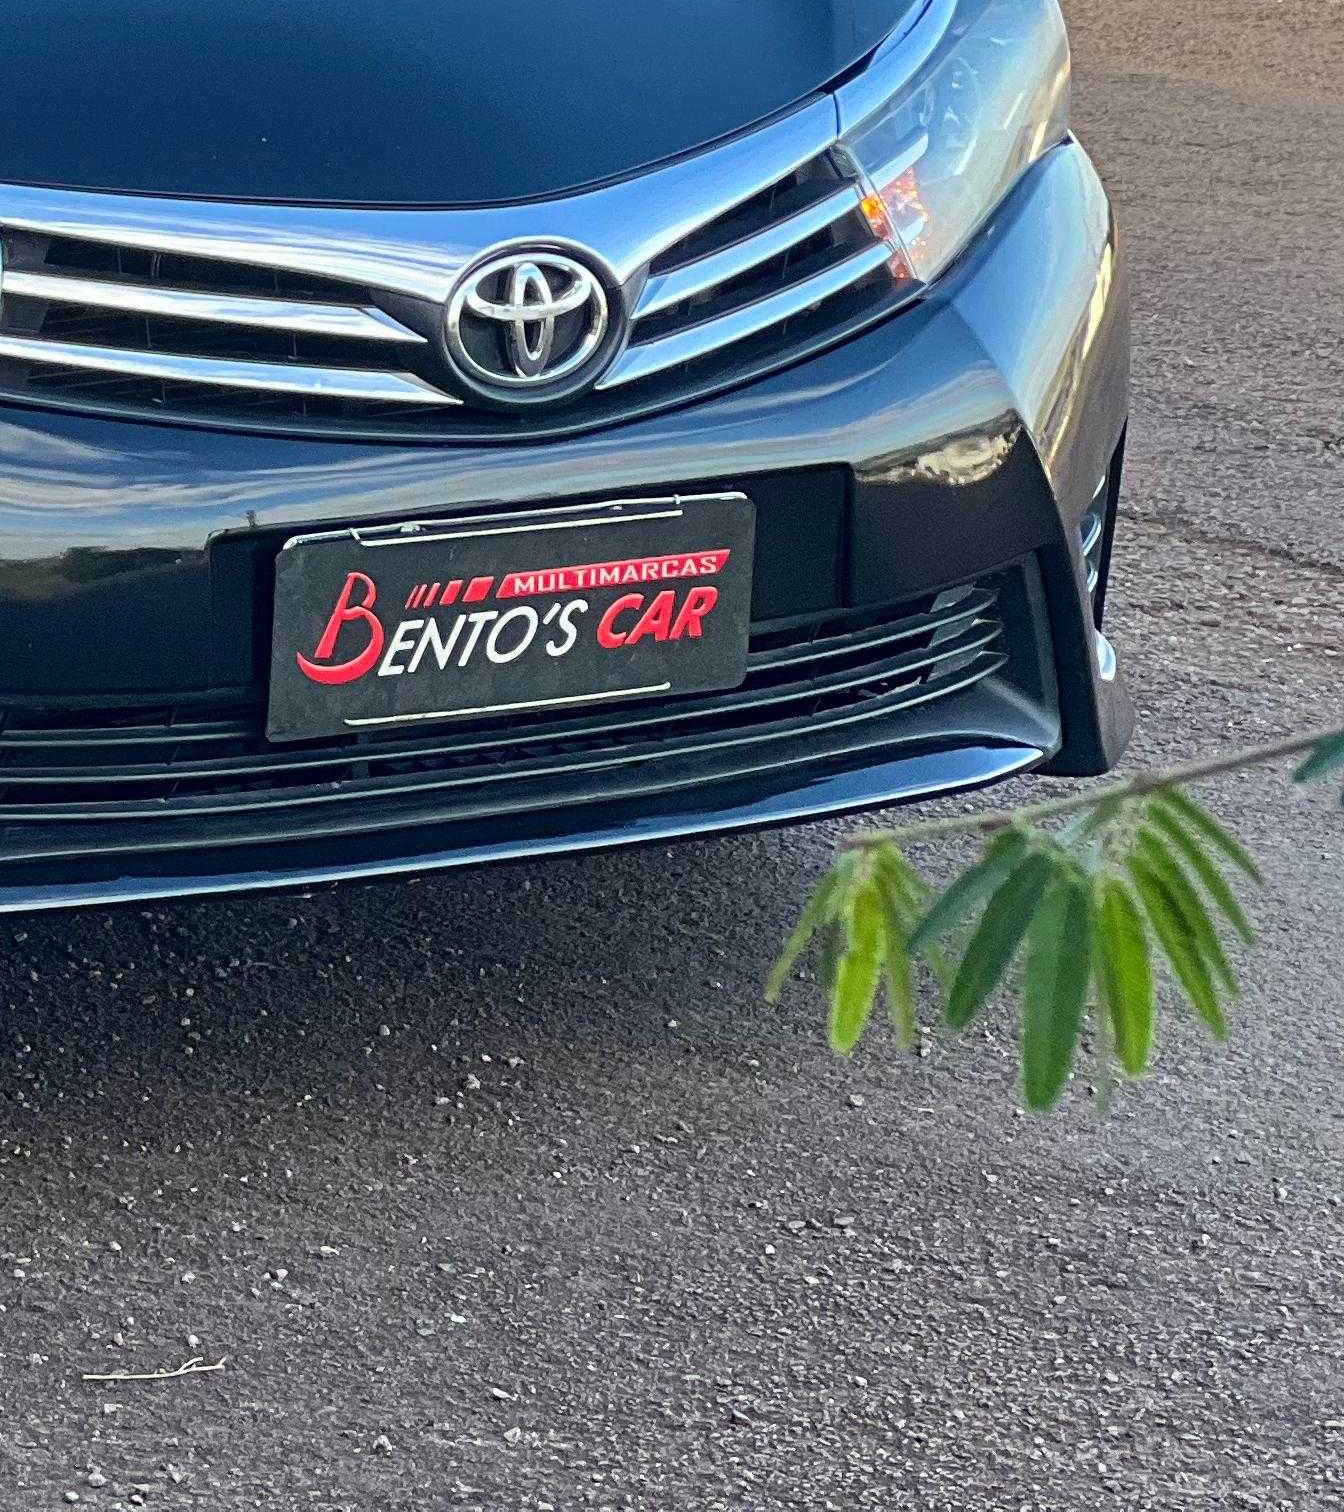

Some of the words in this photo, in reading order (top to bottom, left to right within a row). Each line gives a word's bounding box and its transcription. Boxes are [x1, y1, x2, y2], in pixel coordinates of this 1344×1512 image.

[512, 555, 718, 597] MULTIMARCAS
[296, 572, 589, 685] BENTO'S
[596, 586, 719, 649] CAR
